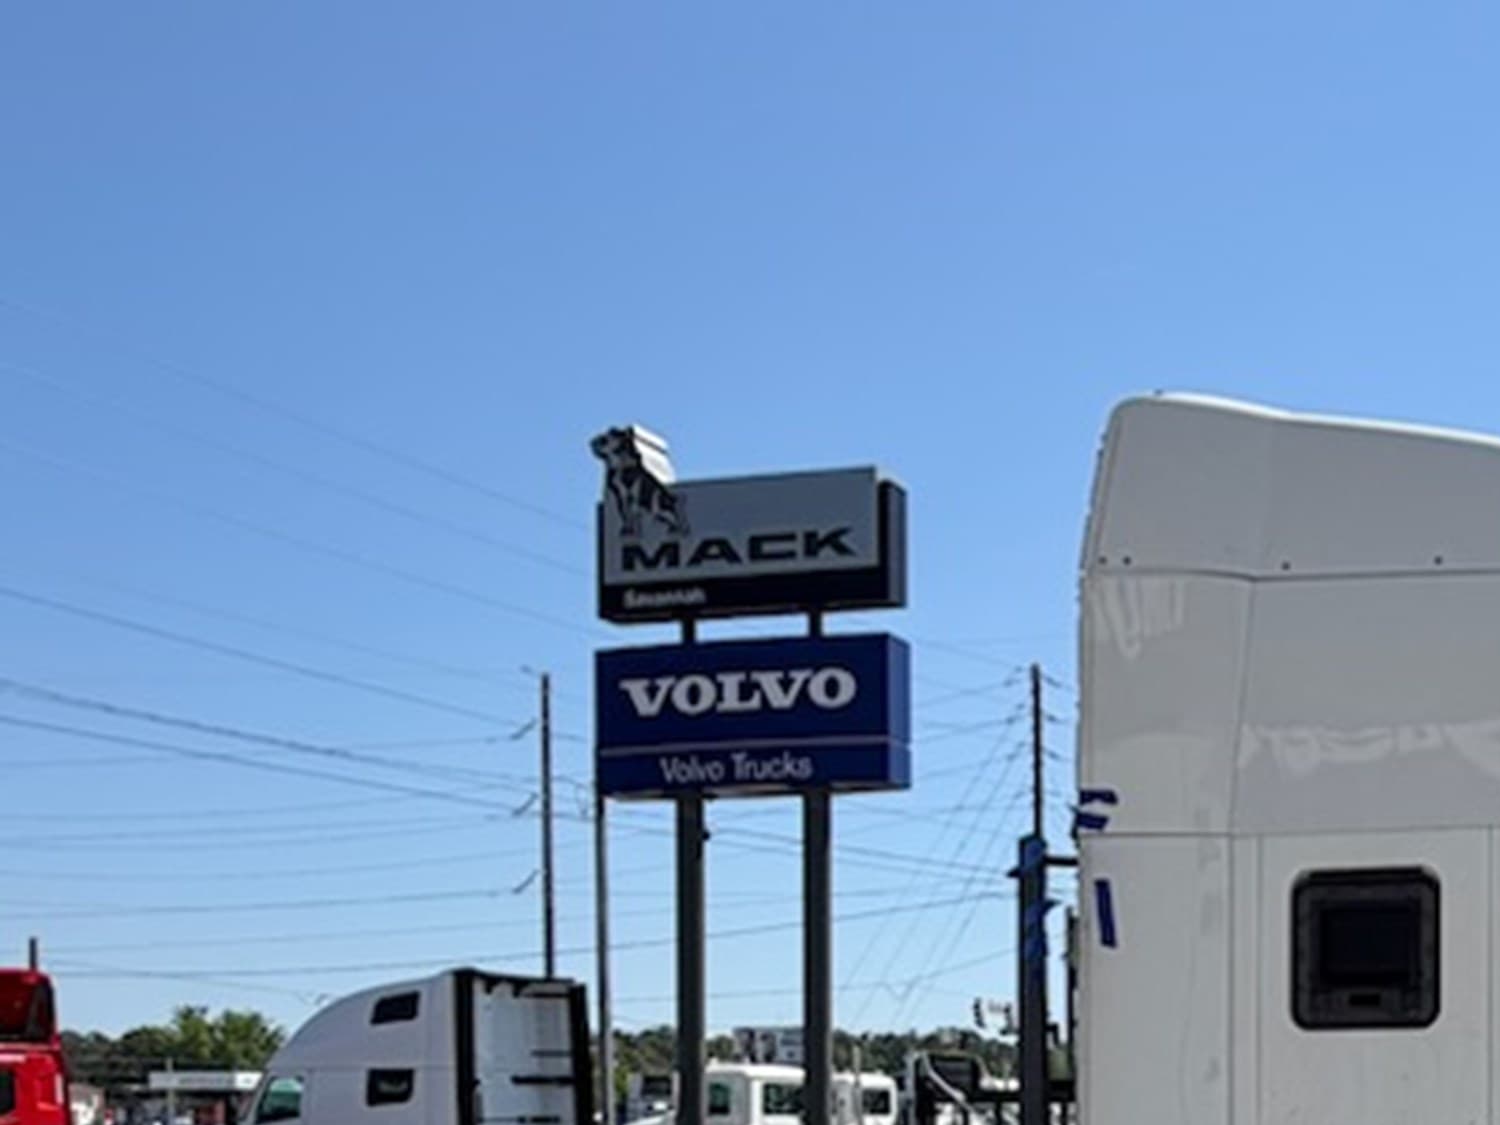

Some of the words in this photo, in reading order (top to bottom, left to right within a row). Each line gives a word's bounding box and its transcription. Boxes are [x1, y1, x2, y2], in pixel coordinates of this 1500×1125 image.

[620, 526, 856, 572] MACK
[618, 666, 857, 718] VOLVO
[658, 755, 725, 784] Volvo
[731, 750, 814, 780] Trucks
